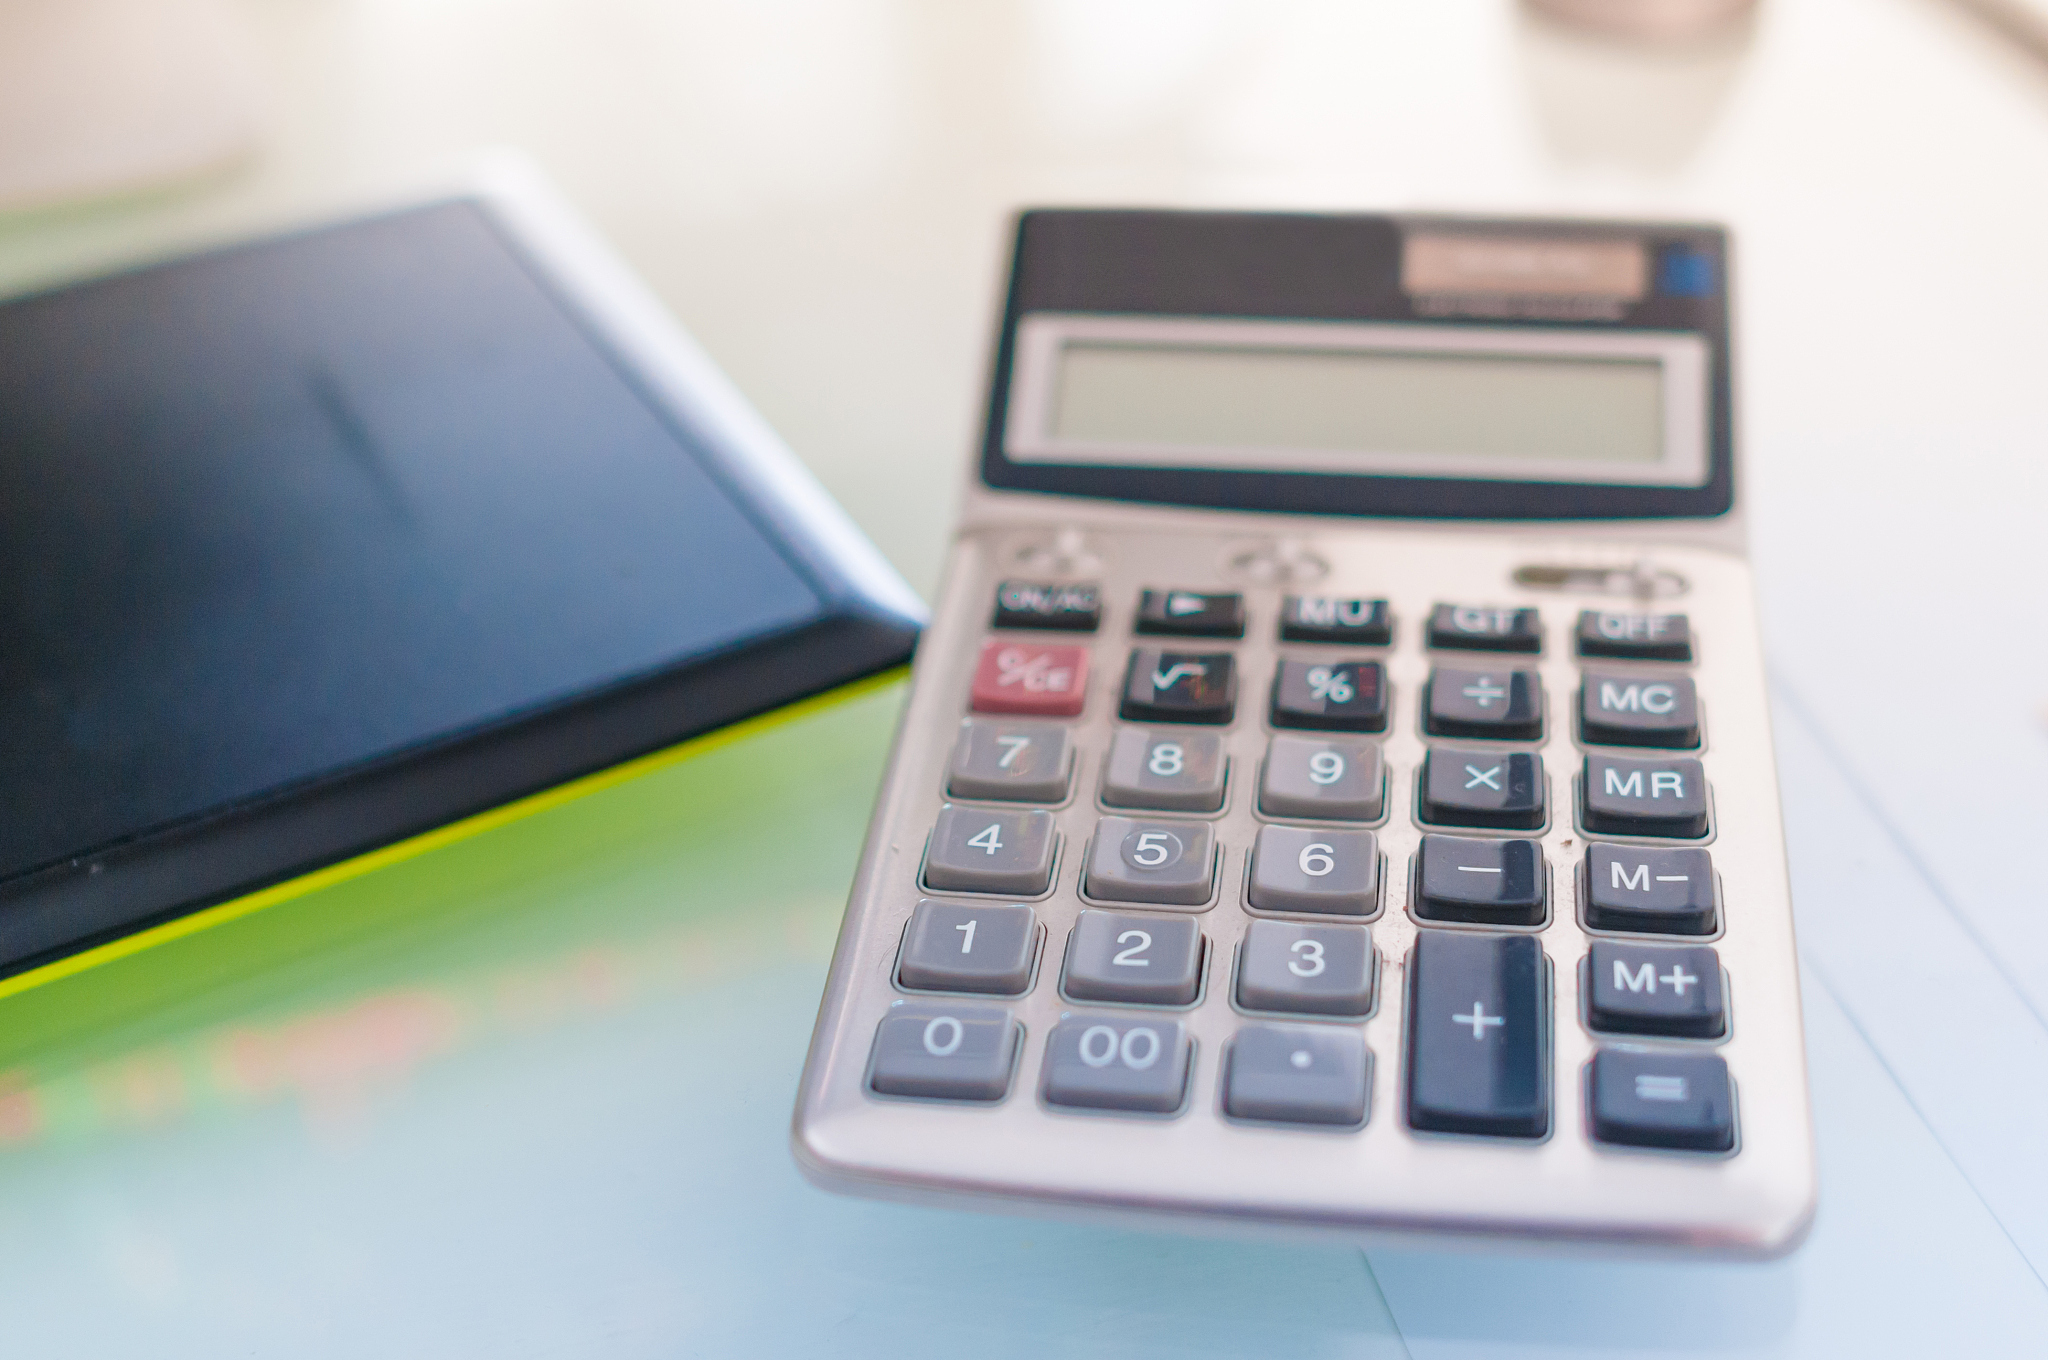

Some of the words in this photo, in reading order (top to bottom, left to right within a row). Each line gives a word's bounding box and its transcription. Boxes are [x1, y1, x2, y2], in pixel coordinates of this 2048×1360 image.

[1299, 597, 1373, 626] MU
[1598, 613, 1669, 639] OFF
[1601, 682, 1674, 714] MC
[996, 737, 1030, 768] 7
[1149, 744, 1183, 776] 8
[1309, 752, 1344, 784] 9
[1605, 768, 1684, 799] MR
[967, 824, 1003, 855] 4
[1133, 833, 1168, 865] 5
[1299, 843, 1335, 876] 6
[955, 920, 978, 954] 1
[1112, 930, 1152, 966] 2
[1288, 939, 1326, 977] 3
[1613, 960, 1698, 996] M+
[923, 1016, 963, 1056] 0
[1452, 1001, 1505, 1039] +
[1079, 1025, 1160, 1070] 00
[1635, 1075, 1687, 1101] =
